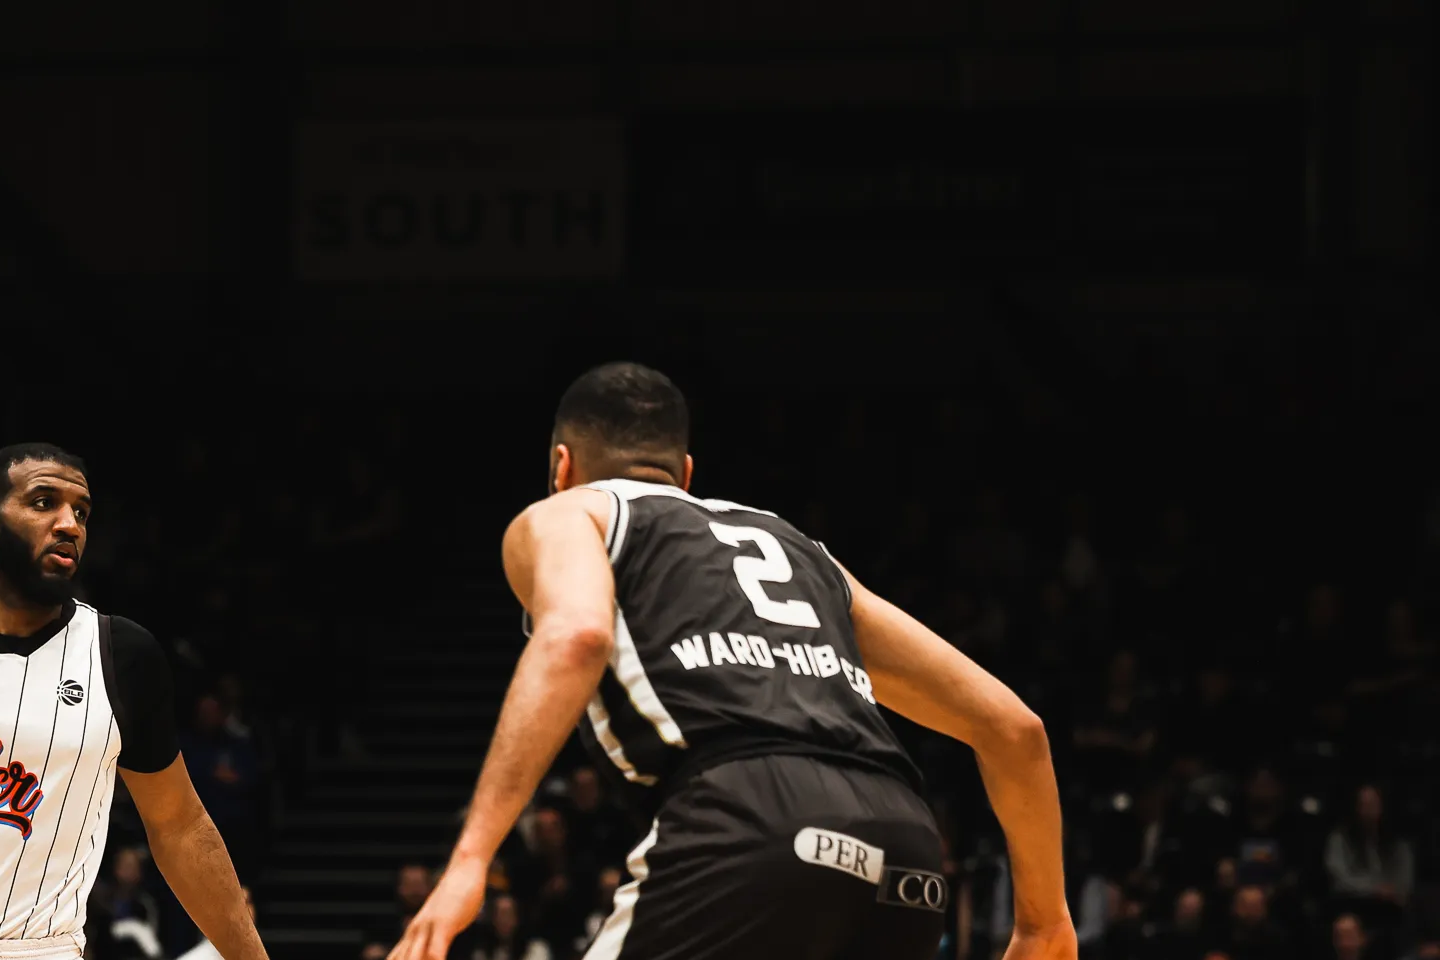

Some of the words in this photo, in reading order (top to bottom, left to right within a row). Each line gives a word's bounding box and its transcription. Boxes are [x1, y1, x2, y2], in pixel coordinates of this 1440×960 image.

[310, 190, 608, 249] SOUTH
[709, 521, 821, 628] 2
[814, 834, 869, 877] PER
[898, 874, 943, 908] CO
